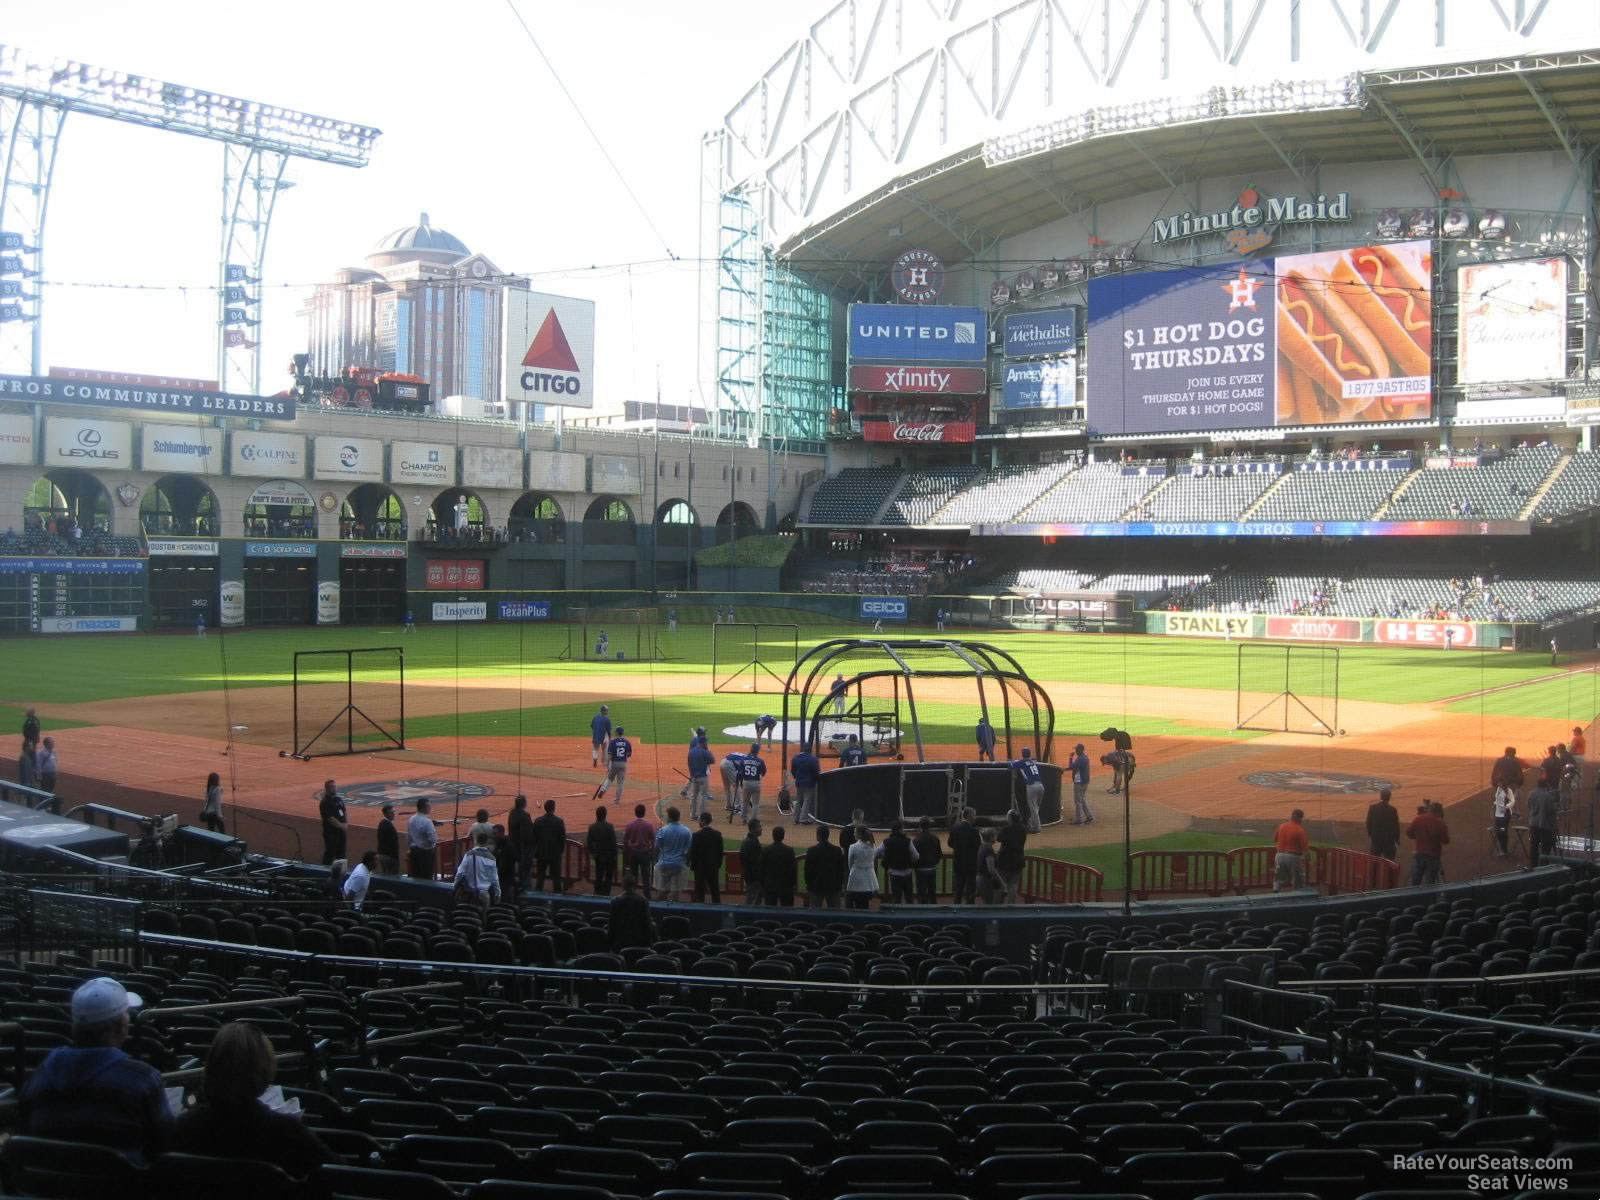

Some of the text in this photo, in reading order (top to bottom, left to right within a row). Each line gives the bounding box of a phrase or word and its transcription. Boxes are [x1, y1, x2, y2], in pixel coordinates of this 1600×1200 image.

[1153, 205, 1262, 243] Minute
[1266, 192, 1350, 223] Maid
[898, 252, 939, 267] HOUSTON
[900, 287, 936, 301] ASTROS
[859, 325, 948, 339] UNITED
[1008, 324, 1071, 342] Methodist
[1124, 318, 1265, 349] $1 HOT DOG
[1131, 343, 1265, 370] THURSDAYS
[520, 372, 580, 394] CITGO
[884, 368, 951, 391] xfinity
[1187, 374, 1265, 390] JOIN US EVERY
[63, 385, 193, 407] COMMUNITY
[202, 396, 285, 414] LEADERS
[1142, 388, 1264, 405] THURSDAY HOME GAME
[1167, 402, 1264, 416] FOR $1 HOT DOGS!
[58, 448, 119, 459] LEXUS
[153, 440, 212, 458] Schlumberger
[256, 449, 297, 460] CALPINE
[400, 460, 447, 472] CHAMPION
[1153, 523, 1293, 535] ROYALS ASTROS
[148, 542, 215, 552] OUSTON CHRONICLE
[446, 604, 485, 618] Insperity
[501, 605, 547, 617] TexanPlus
[862, 602, 905, 613] GEICO
[1047, 600, 1108, 611] LEXUS
[1169, 616, 1249, 633] STANLEY
[616, 747, 626, 757] 12
[744, 765, 757, 776] 59
[1030, 764, 1039, 776] 19
